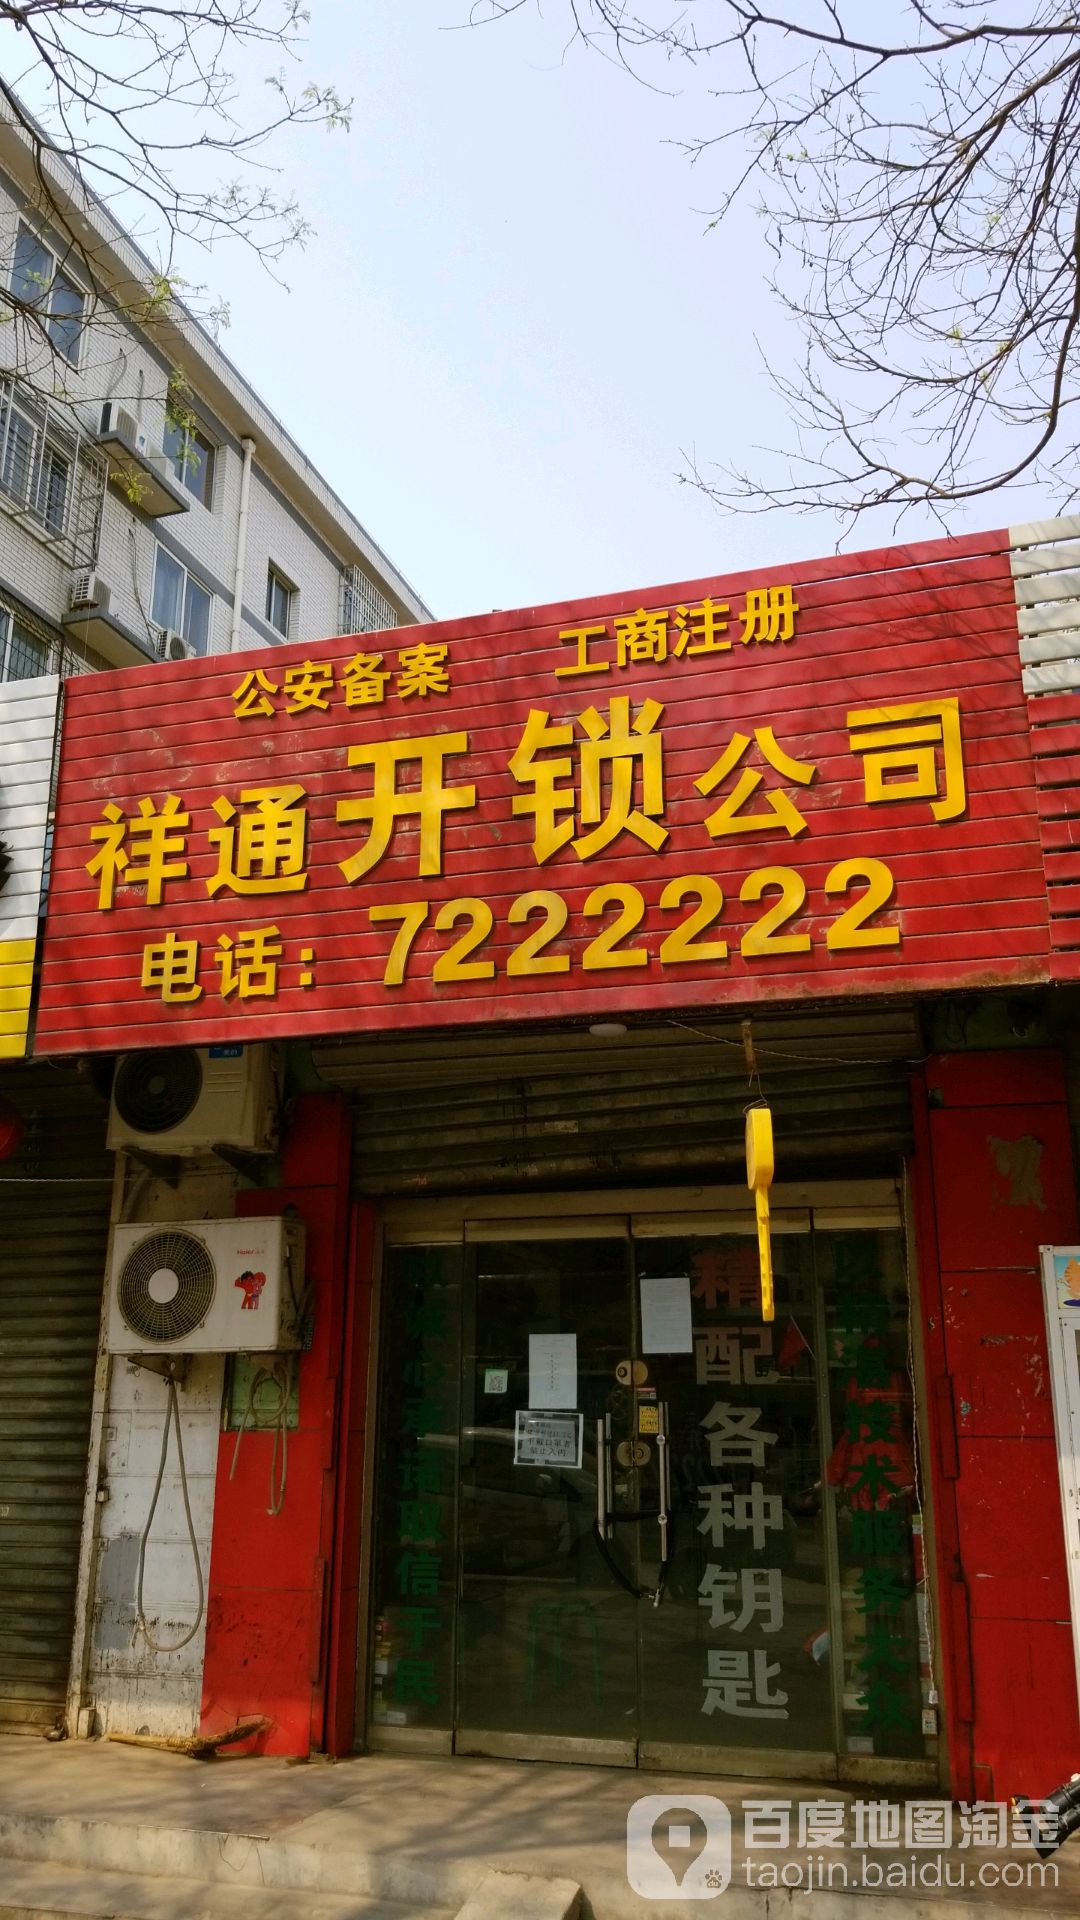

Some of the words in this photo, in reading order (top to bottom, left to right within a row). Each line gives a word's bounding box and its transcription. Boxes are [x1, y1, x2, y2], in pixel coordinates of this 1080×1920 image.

[231, 642, 450, 719] 公安备案
[553, 585, 801, 678] 工商注册
[86, 695, 968, 911] 祥通开锁公司
[367, 857, 902, 987] 7222222
[692, 1247, 789, 1719] 精配各种钥匙
